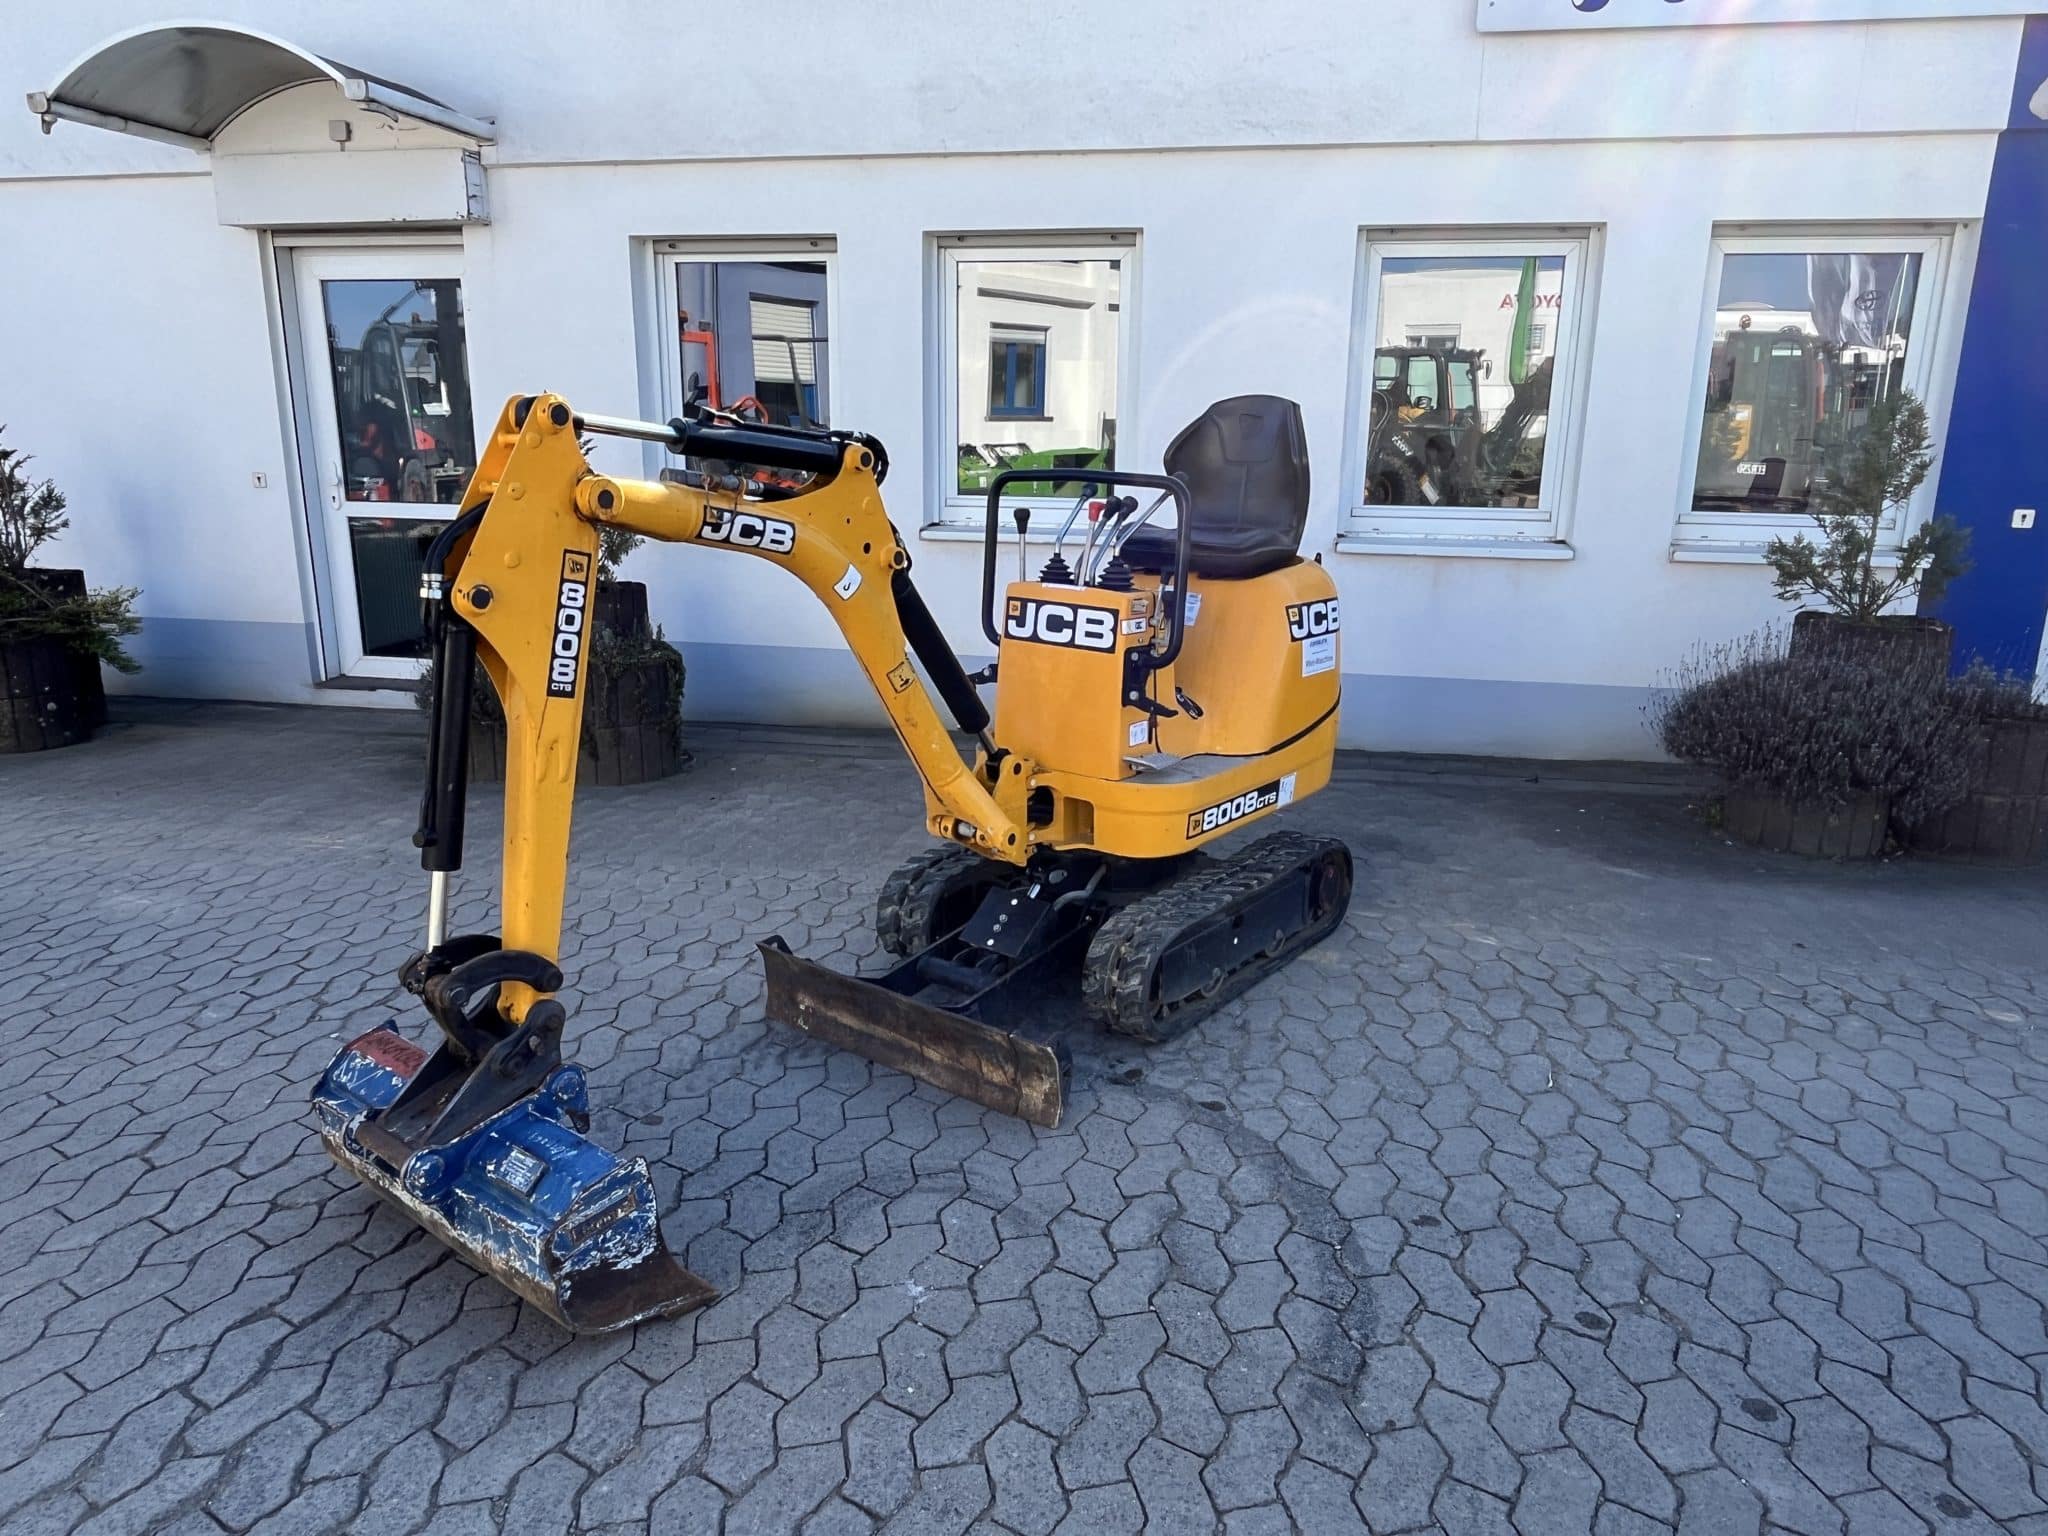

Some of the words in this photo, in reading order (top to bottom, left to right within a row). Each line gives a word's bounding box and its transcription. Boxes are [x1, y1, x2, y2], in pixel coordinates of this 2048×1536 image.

[701, 509, 794, 553] JCB
[552, 582, 585, 683] 8008
[1007, 602, 1115, 649] JCB
[1291, 600, 1340, 638] JCB
